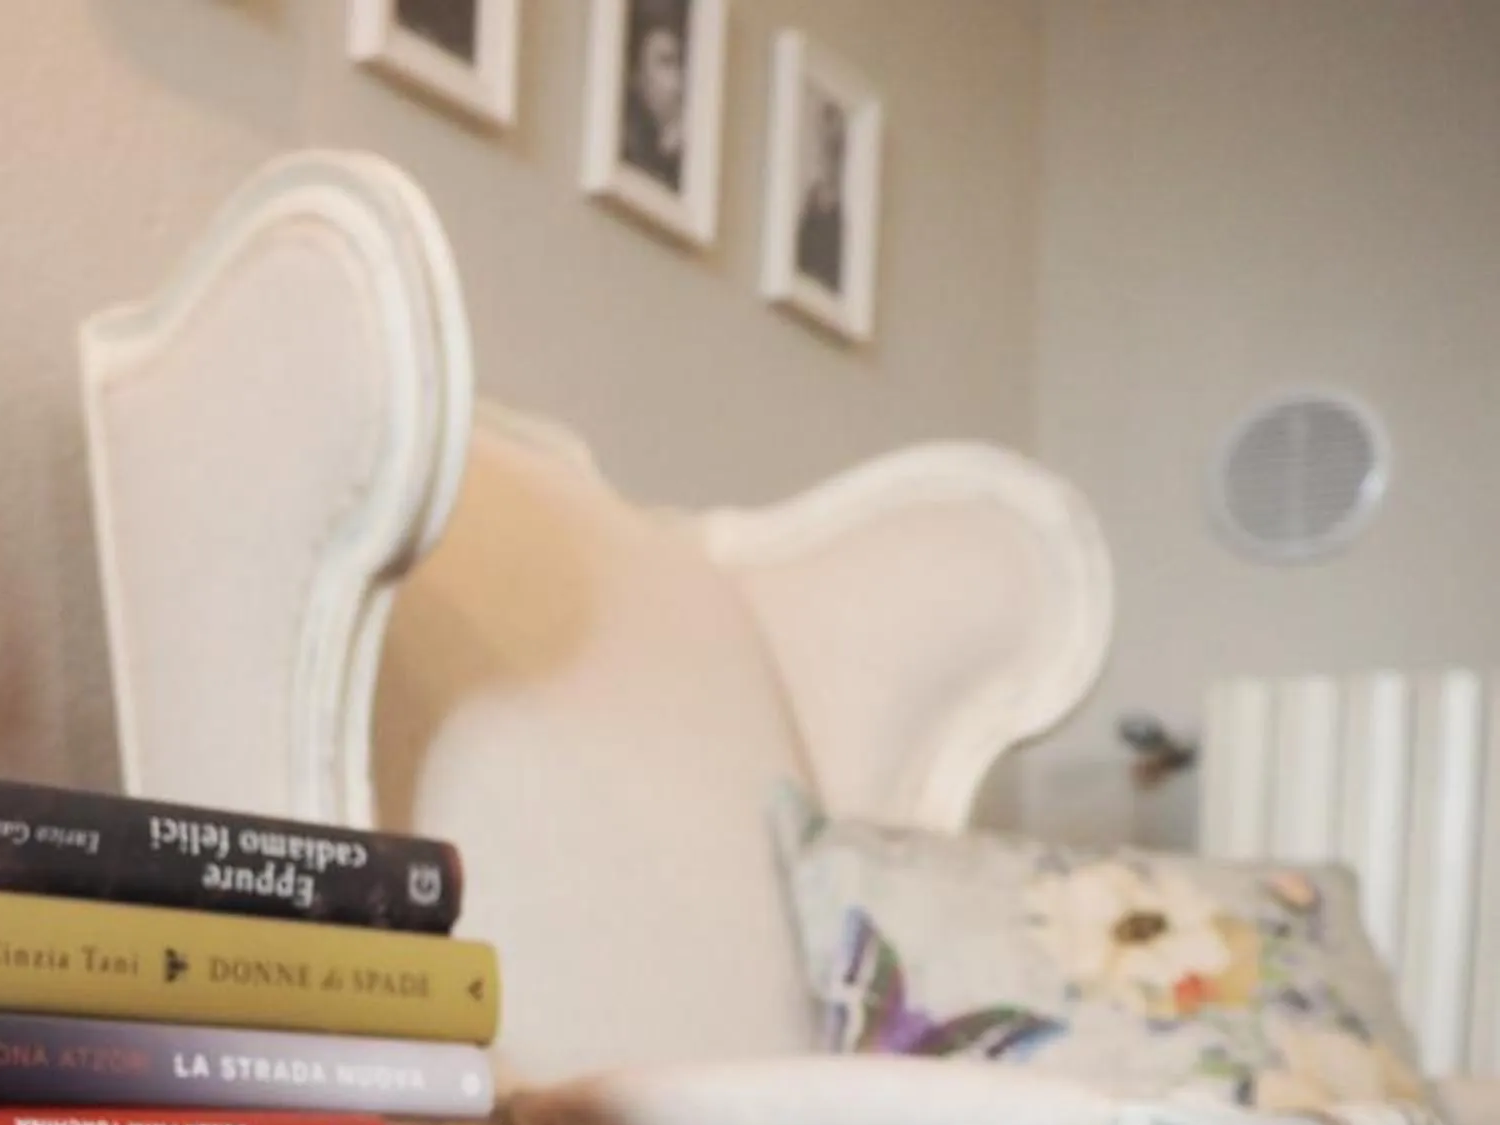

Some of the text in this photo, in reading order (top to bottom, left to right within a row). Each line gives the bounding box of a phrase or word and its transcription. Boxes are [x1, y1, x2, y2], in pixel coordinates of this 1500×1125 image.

[150, 816, 368, 872] cadiamo felici
[202, 862, 314, 908] Eppure
[81, 945, 139, 975] Tani
[209, 957, 310, 988] DONNE
[173, 1053, 210, 1079] LA
[220, 1055, 327, 1086] STRADA
